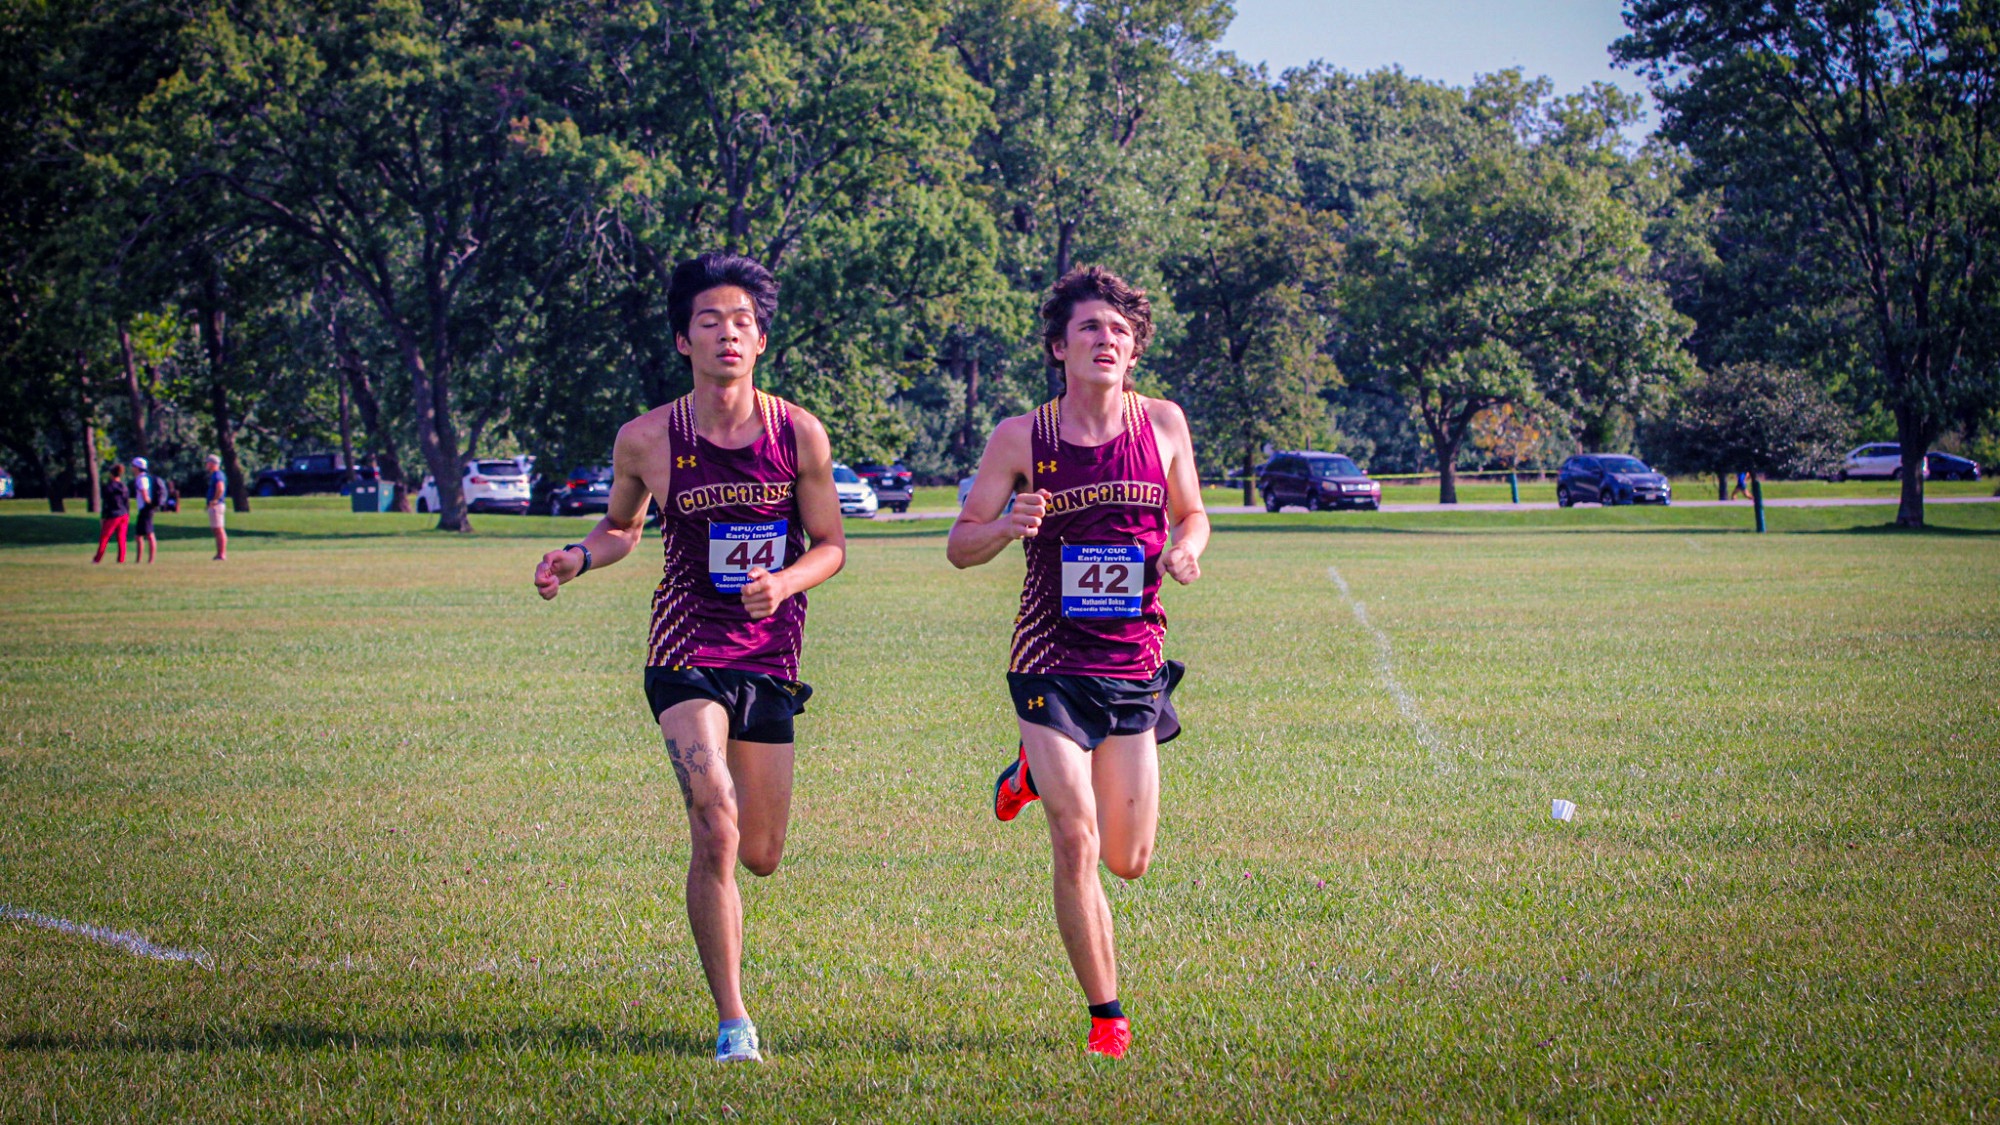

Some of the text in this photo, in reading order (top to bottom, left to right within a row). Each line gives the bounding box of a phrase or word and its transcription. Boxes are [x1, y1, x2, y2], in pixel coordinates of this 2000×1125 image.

[731, 524, 774, 533] NPU/CUC
[726, 540, 774, 570] 44
[1078, 564, 1129, 593] 42
